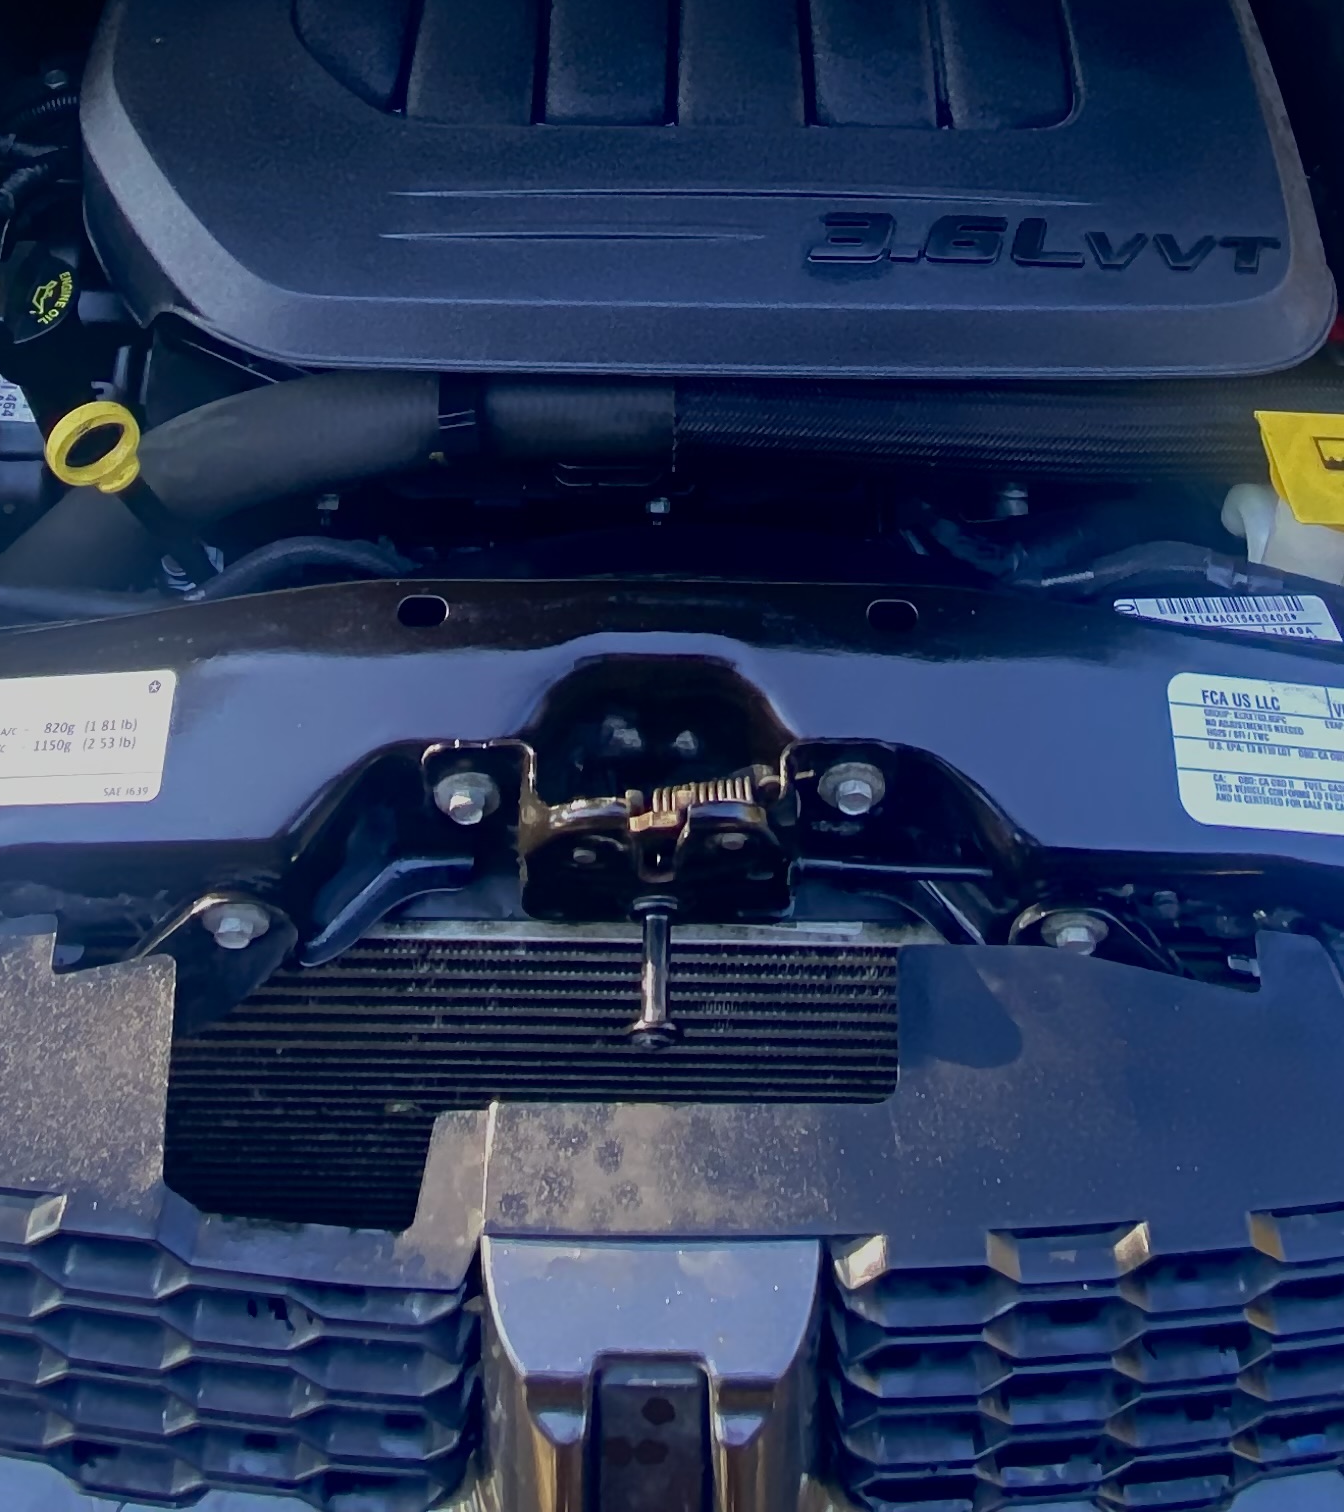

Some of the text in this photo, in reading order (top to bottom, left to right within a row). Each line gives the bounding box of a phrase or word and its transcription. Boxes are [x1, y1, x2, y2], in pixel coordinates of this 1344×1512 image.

[37, 271, 73, 325] ENGINE OIL
[1201, 689, 1281, 711] FCA US LLC
[0, 727, 18, 737] A/C
[43, 722, 76, 736] 820g
[120, 717, 137, 733] lb)
[33, 739, 73, 753] 1150g
[119, 736, 136, 750] lb)
[103, 786, 122, 797] SAE
[1234, 785, 1266, 796] VEHICLE
[1312, 790, 1324, 800] TO
[1216, 793, 1232, 802] AND
[1244, 795, 1284, 807] CERTIFIED
[1285, 798, 1302, 808] FOR
[1304, 800, 1322, 810] SALE
